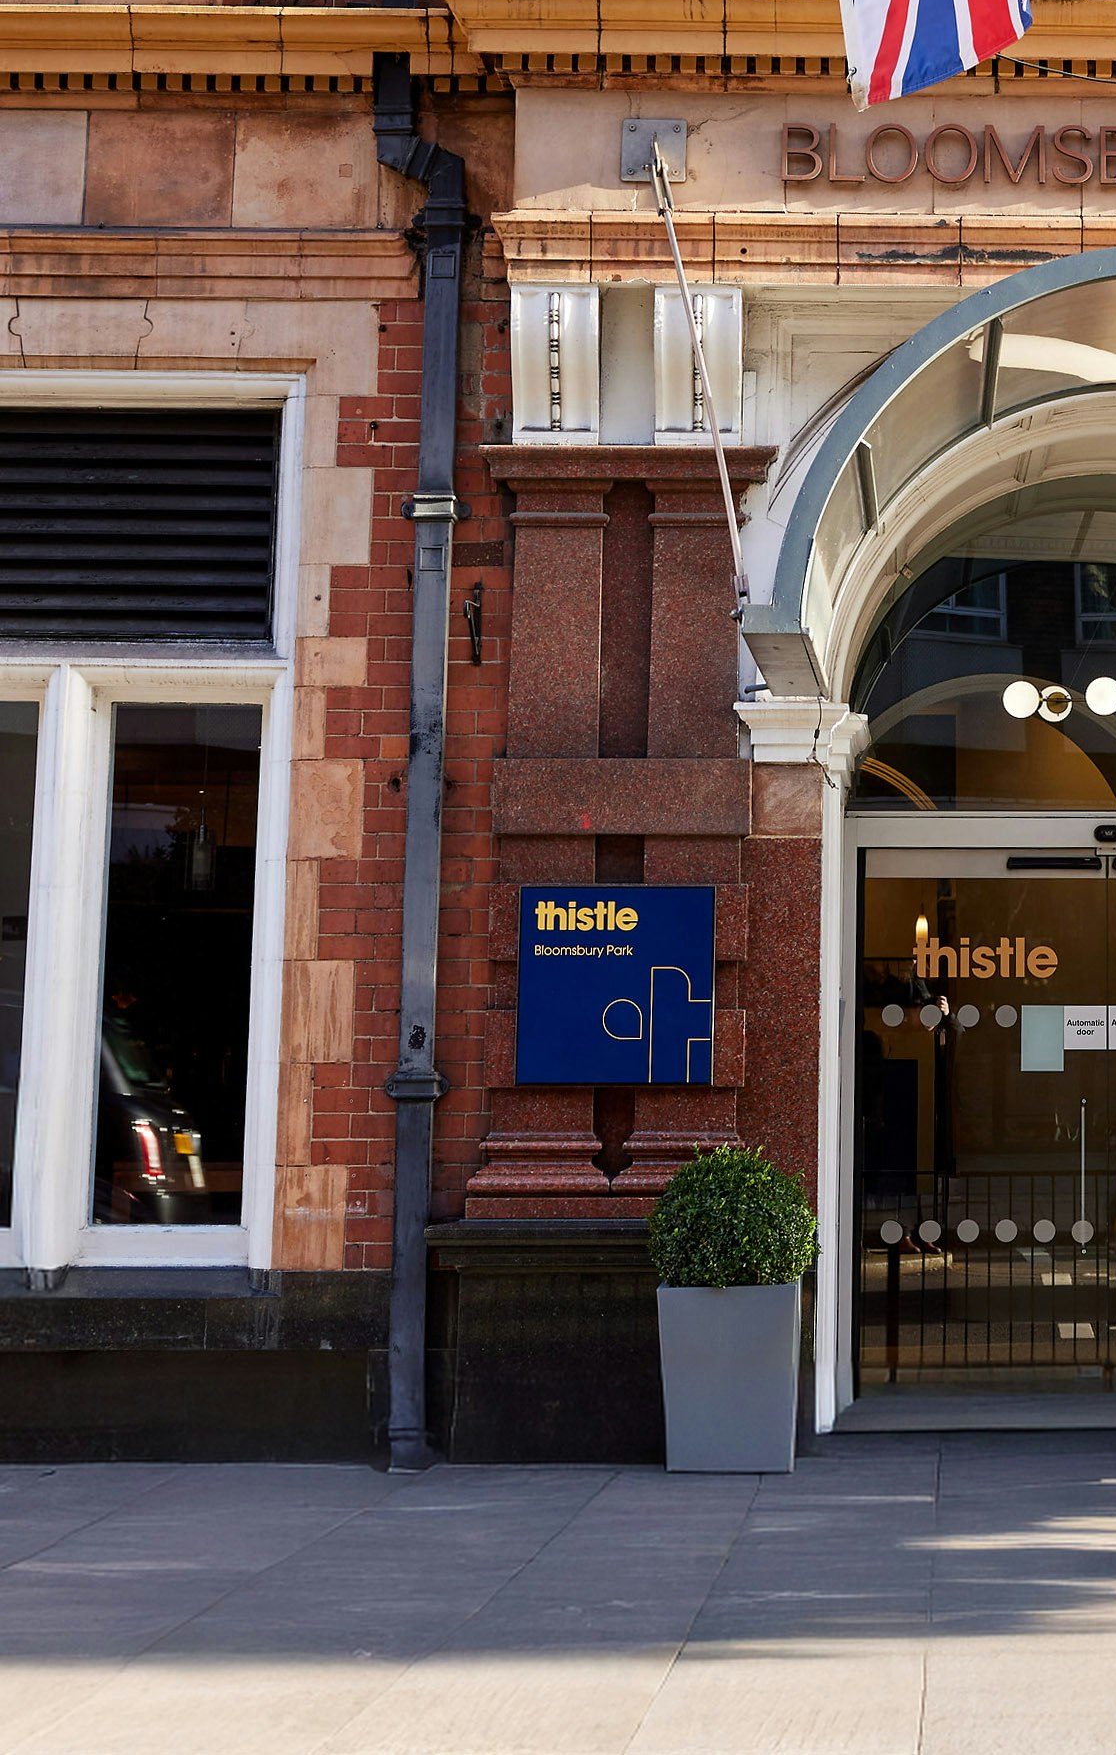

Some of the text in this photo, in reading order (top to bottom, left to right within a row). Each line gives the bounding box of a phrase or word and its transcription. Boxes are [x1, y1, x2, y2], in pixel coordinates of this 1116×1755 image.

[535, 901, 639, 931] thistle
[534, 945, 633, 958] Bloomsbury Park
[912, 937, 1059, 979] thistle
[1066, 1019, 1105, 1027] Automatic
[1076, 1028, 1095, 1036] door
